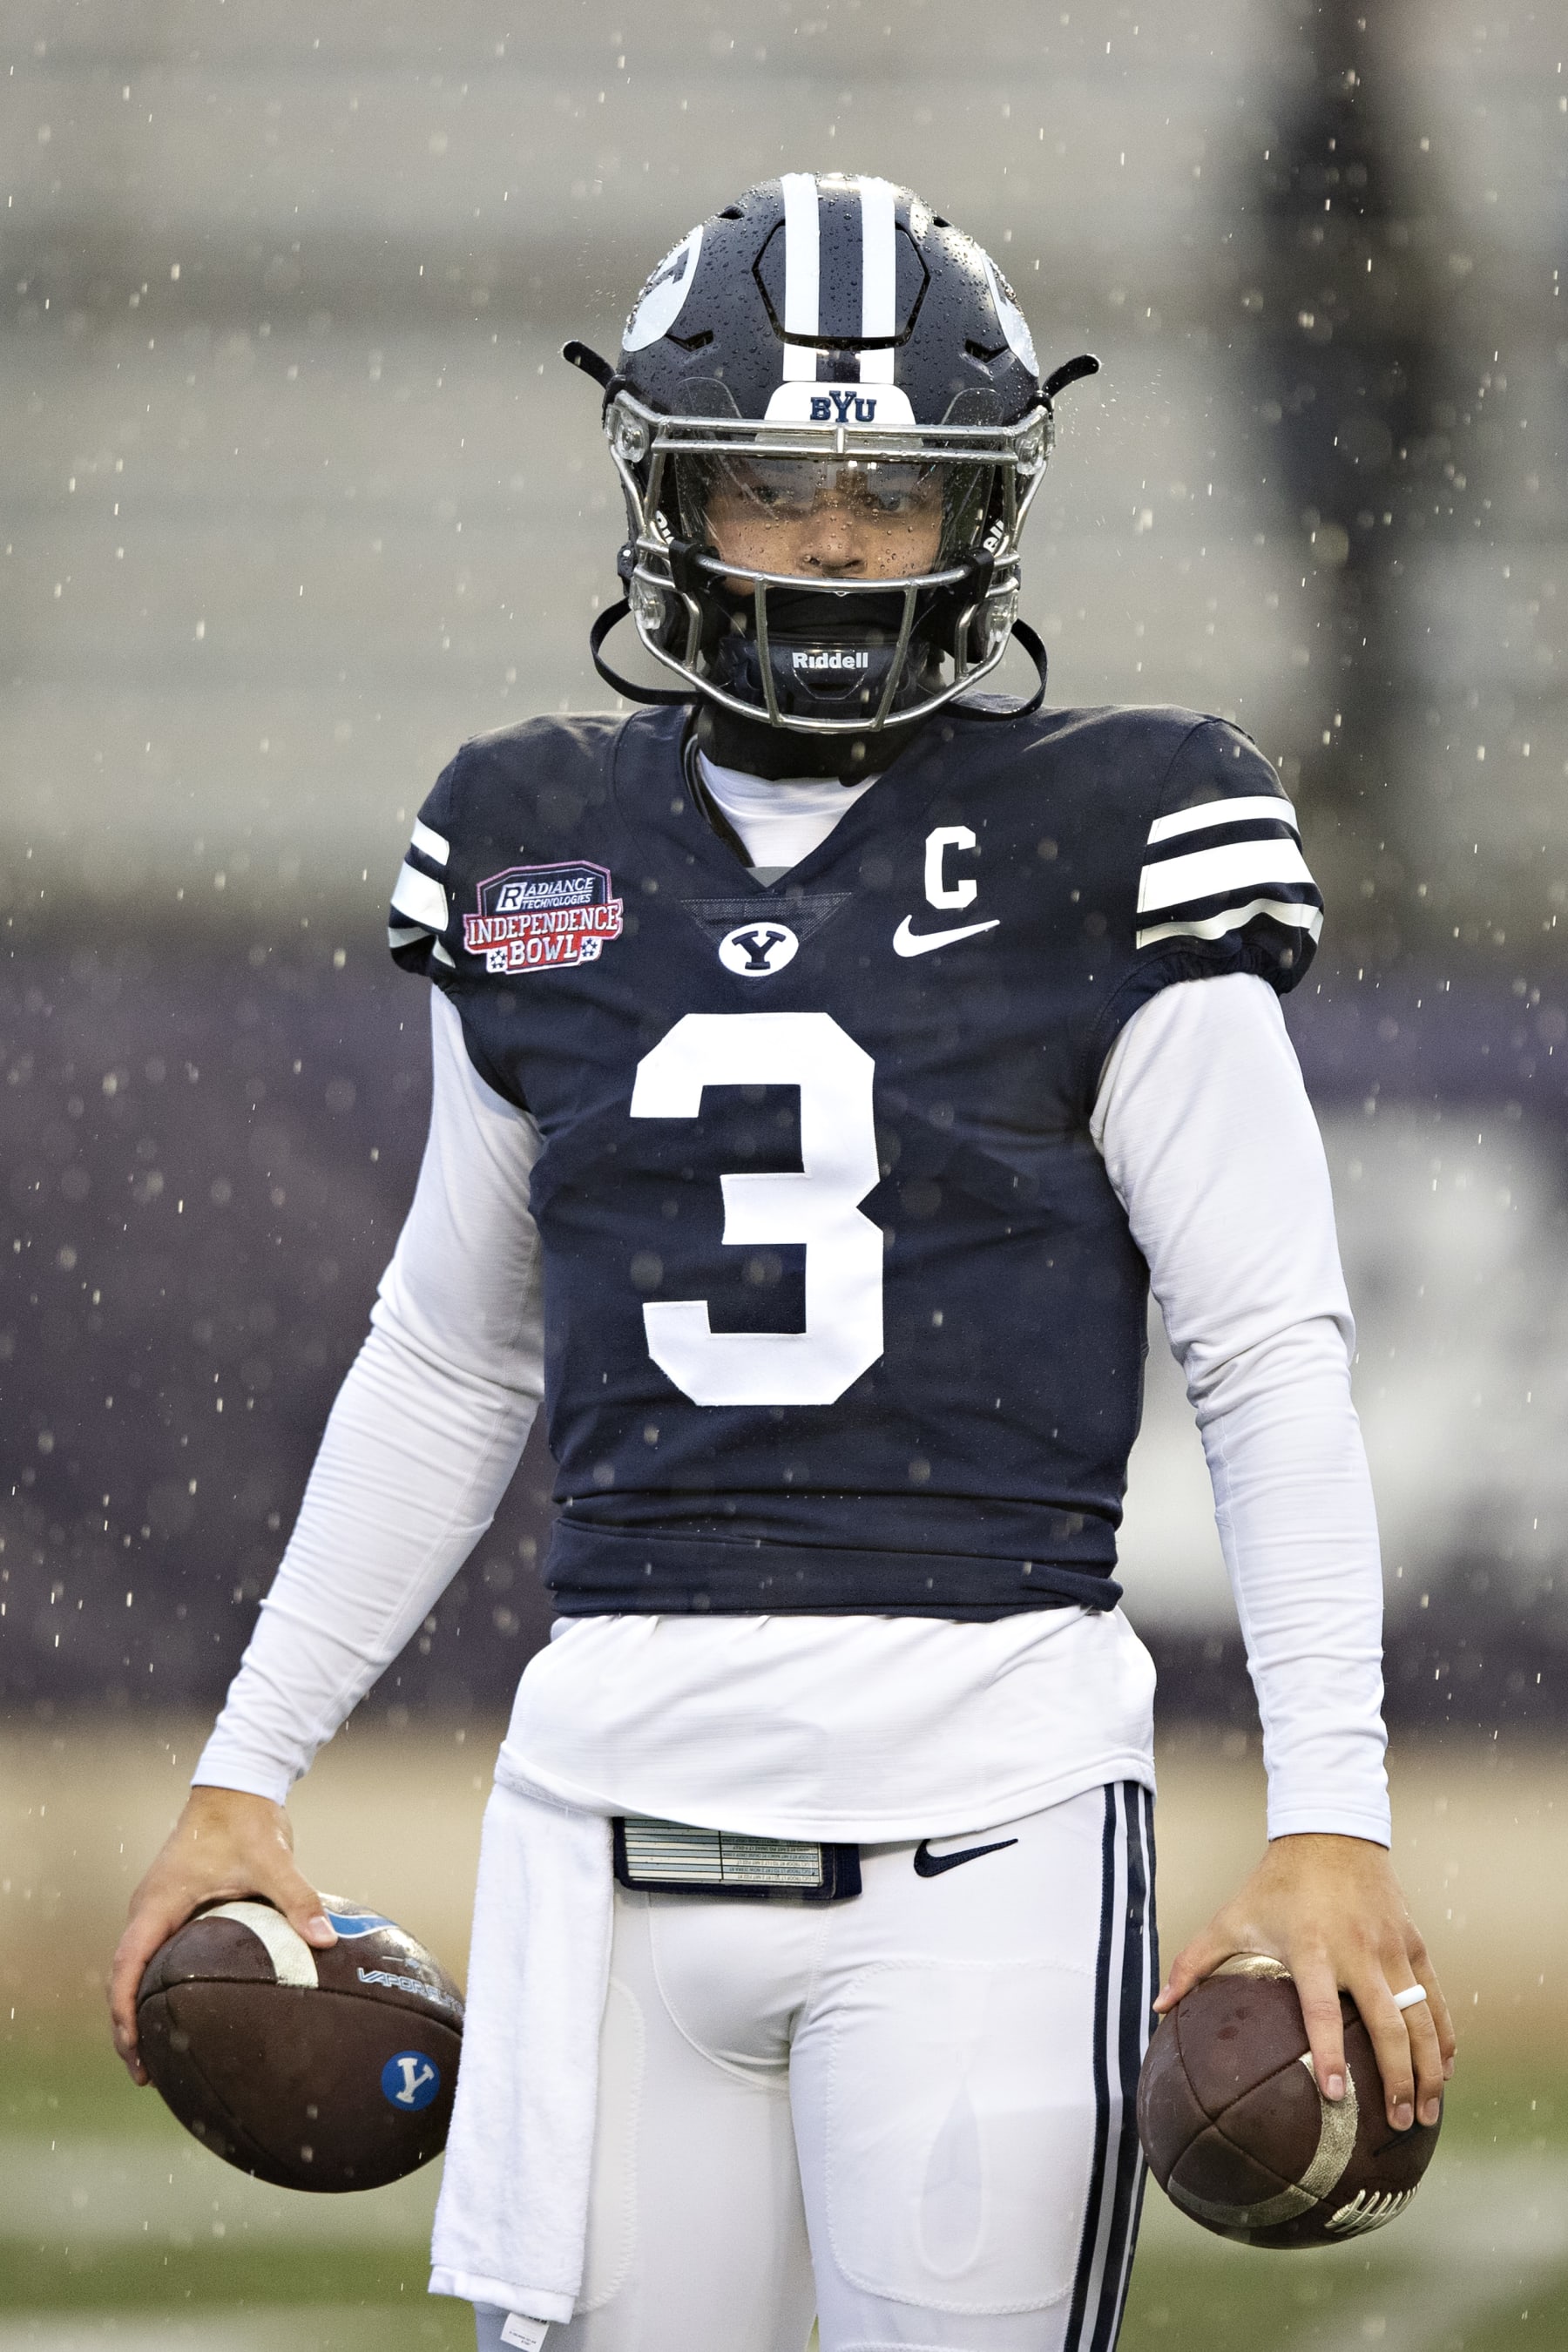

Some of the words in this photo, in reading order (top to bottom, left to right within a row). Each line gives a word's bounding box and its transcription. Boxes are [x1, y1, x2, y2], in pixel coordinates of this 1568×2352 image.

[810, 390, 877, 423] BYU
[792, 652, 868, 669] Riddell
[924, 825, 977, 909] C
[497, 876, 595, 910] RADIANCE
[522, 893, 592, 910] TECHNOLOGIES
[469, 905, 618, 946] INDEPENDENCE
[509, 934, 578, 966] BOWL
[731, 929, 787, 970] Y
[630, 1011, 884, 1406] 3
[395, 2057, 435, 2104] Y
